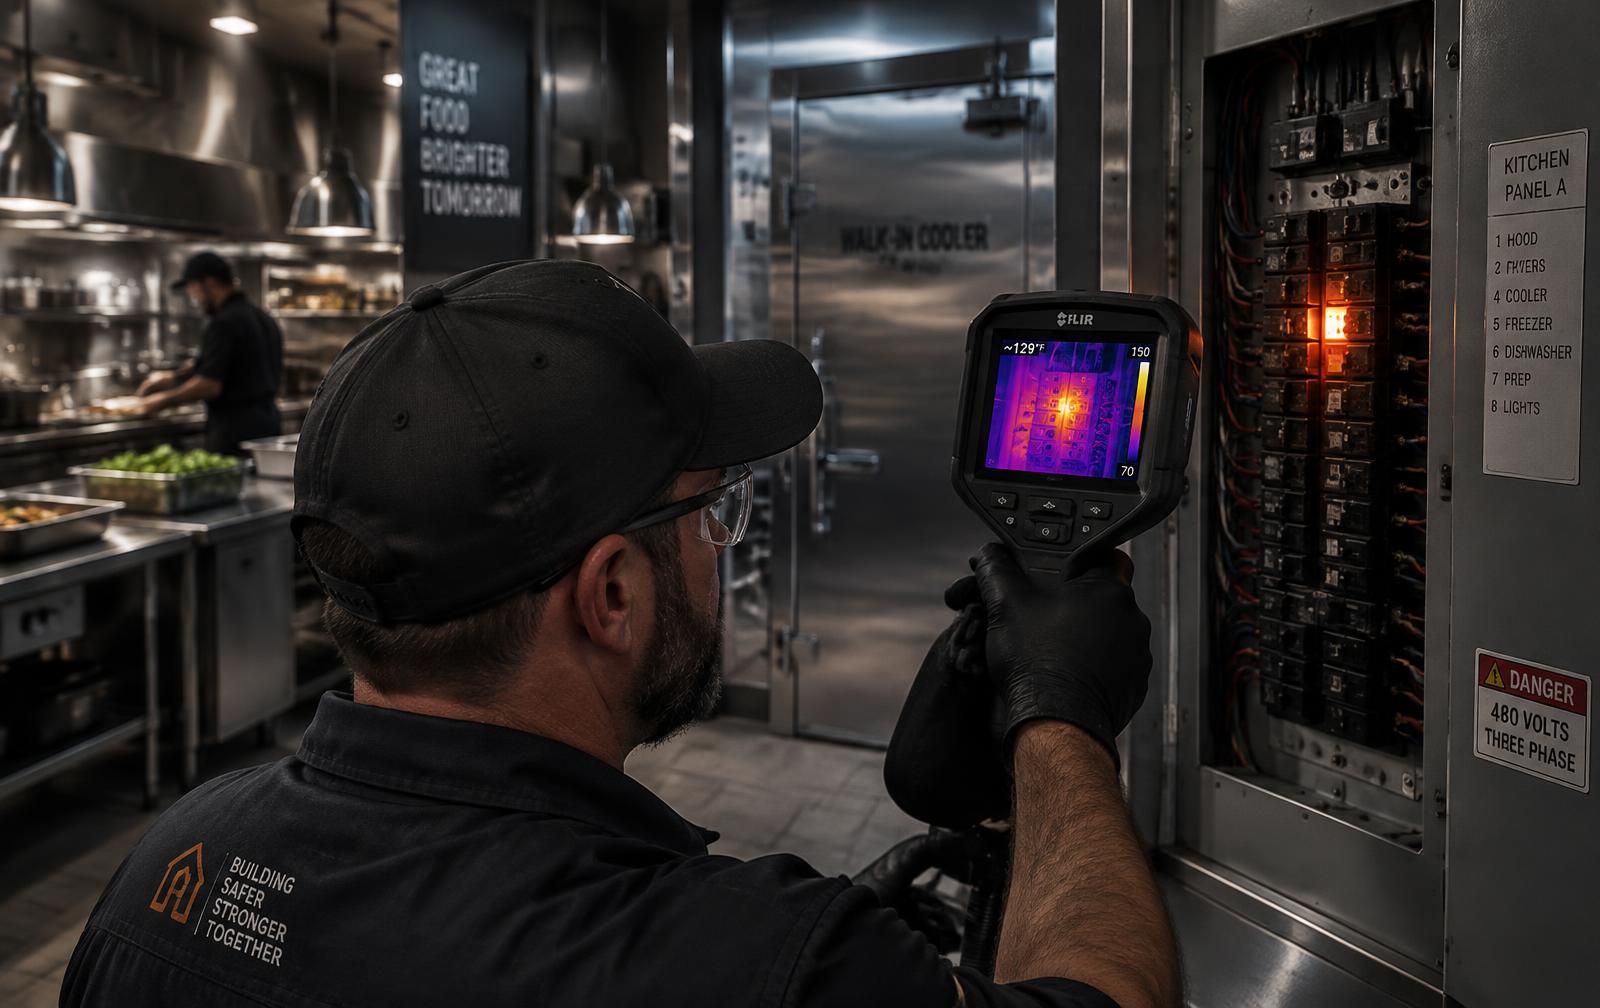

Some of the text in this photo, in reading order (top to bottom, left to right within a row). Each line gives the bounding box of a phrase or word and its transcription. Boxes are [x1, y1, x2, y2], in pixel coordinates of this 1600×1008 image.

[419, 51, 480, 95] GREAT
[420, 93, 470, 134] FOOD
[420, 137, 510, 179] BRIGHTER
[1504, 148, 1569, 175] KITCHEN
[420, 178, 522, 217] TOMORROW
[1505, 177, 1567, 202] PANEL A
[840, 221, 990, 255] WALK-IN COOLER
[1495, 231, 1538, 248] 1 HOOD
[1494, 260, 1501, 275] 2
[1493, 288, 1547, 304] 4 COOLER
[1068, 313, 1094, 326] FLIR
[1493, 316, 1553, 331] 5 FREEZER
[1131, 346, 1151, 357] 150
[1492, 345, 1572, 360] 6 DISHWASHER
[1492, 372, 1532, 387] 7 PREP
[1491, 400, 1541, 416] 8 LIGHTS
[1120, 466, 1135, 477] 70
[1510, 669, 1574, 706] DANGER
[1490, 702, 1569, 742] 480 VOLTS
[1484, 727, 1576, 773] THREE PHASE
[229, 856, 296, 895] BUILDING
[221, 877, 265, 909] SAFER
[212, 897, 287, 943] STRONGER
[206, 919, 283, 967] TOGETHER
